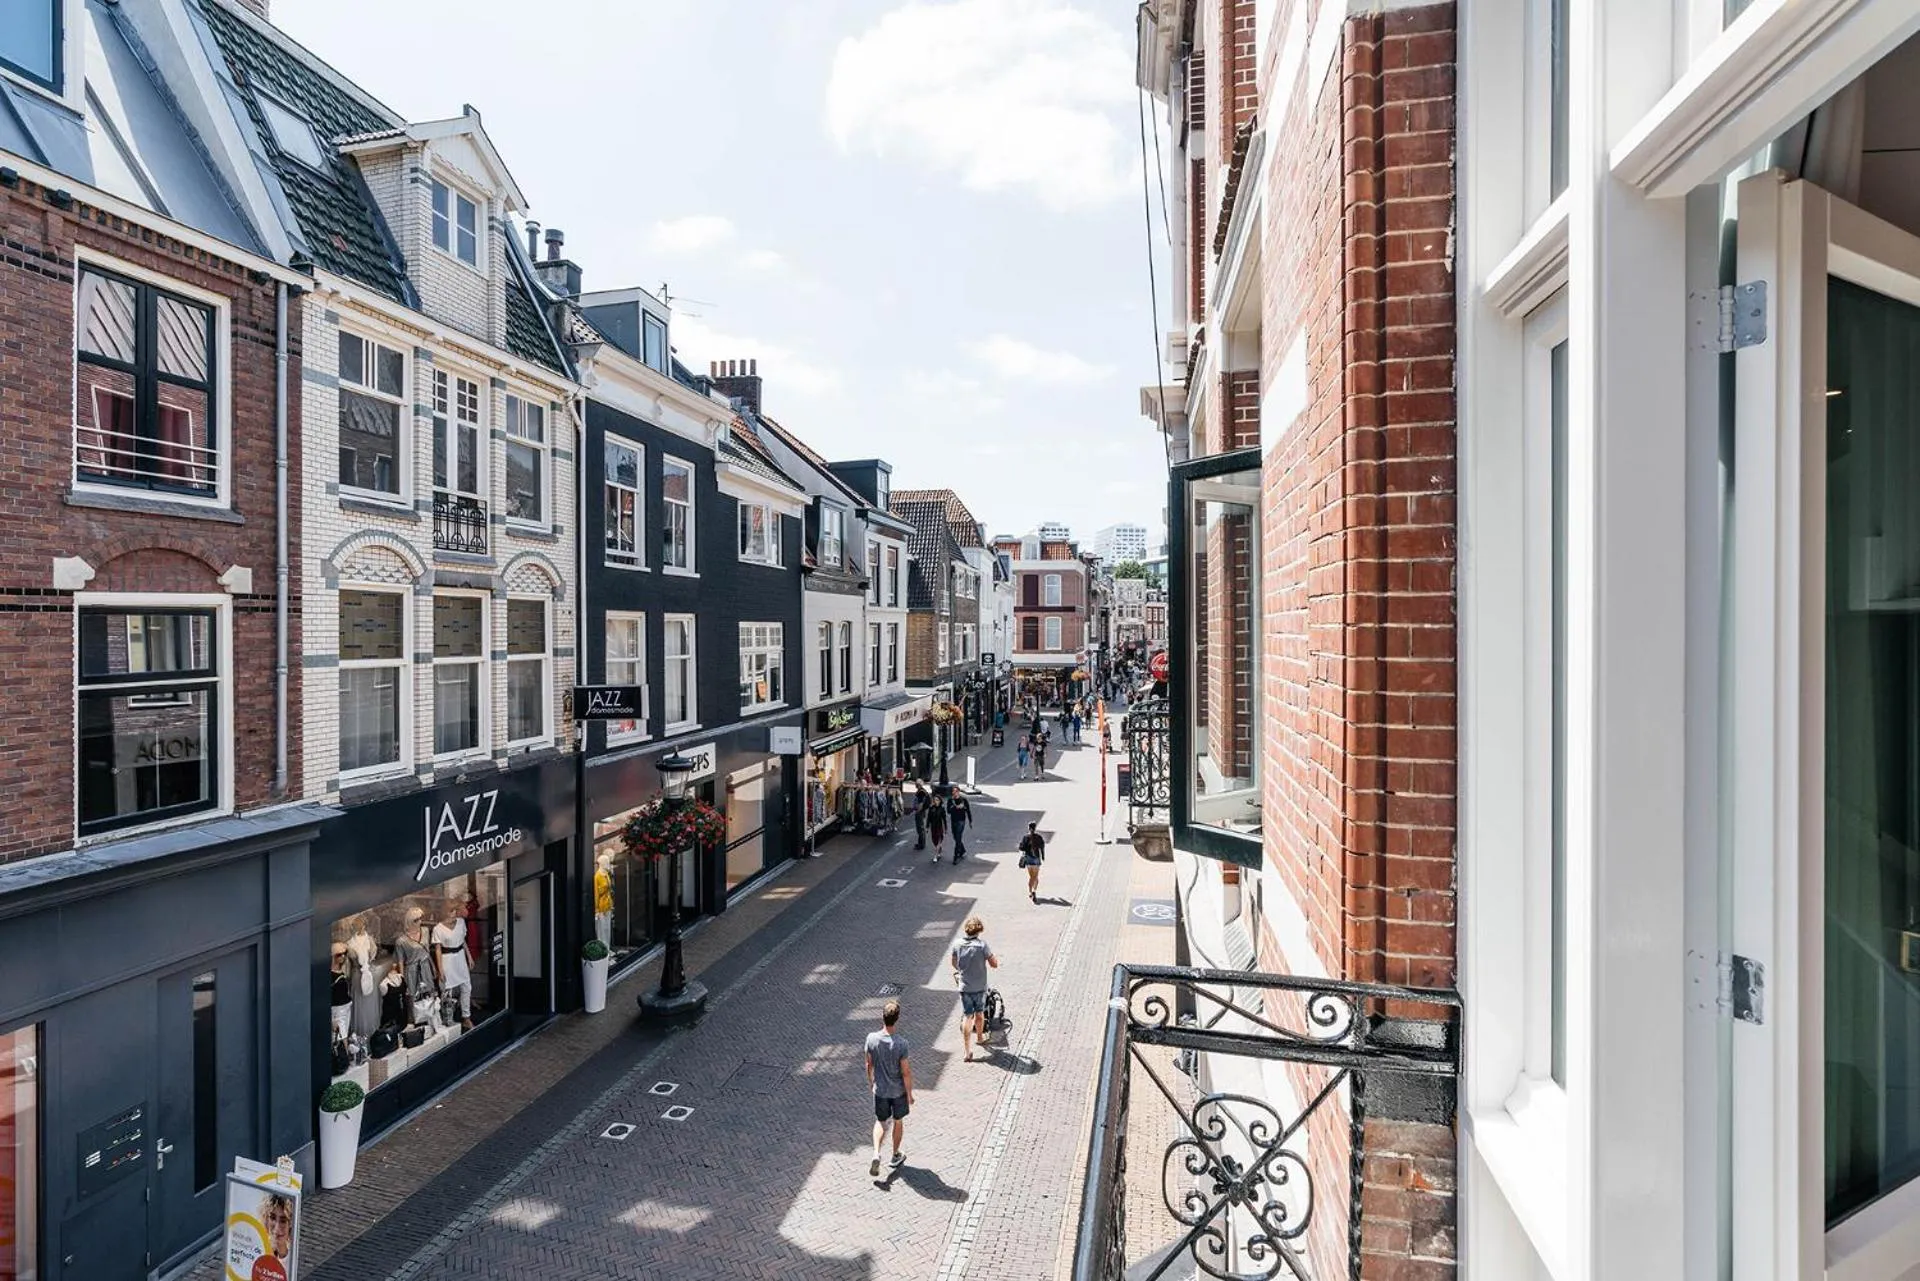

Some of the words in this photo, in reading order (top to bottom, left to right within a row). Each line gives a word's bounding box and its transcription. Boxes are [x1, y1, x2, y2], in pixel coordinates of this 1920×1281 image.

[585, 690, 621, 716] JAZZ
[591, 706, 635, 714] damesmode
[416, 789, 499, 881] JAZZ
[429, 827, 521, 870] damesmode
